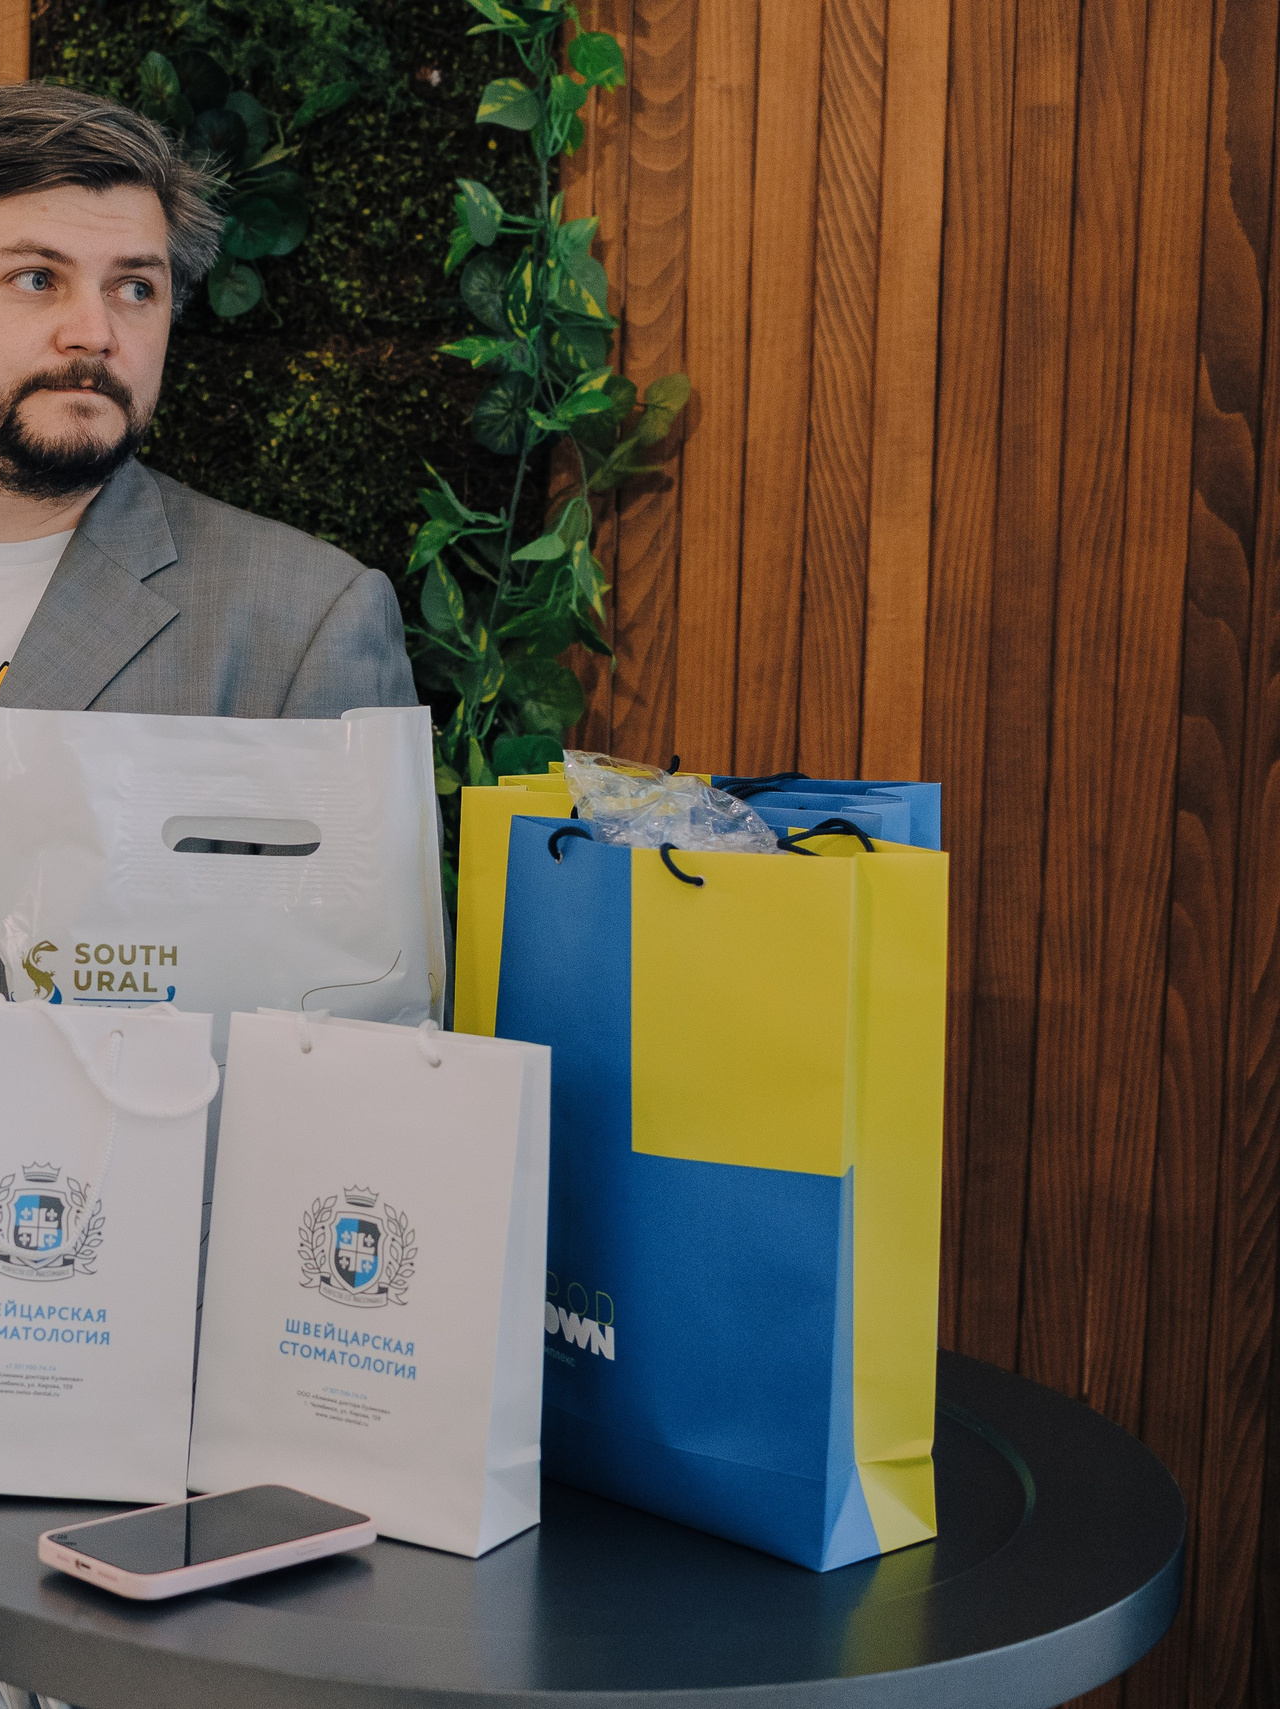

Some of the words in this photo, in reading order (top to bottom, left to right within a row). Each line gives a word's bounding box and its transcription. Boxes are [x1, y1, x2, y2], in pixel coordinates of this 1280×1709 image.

[74, 942, 178, 967] SOUTH
[73, 969, 158, 993] URAL
[285, 1318, 415, 1357] ШВЕЙЦАРСКАЯ
[278, 1340, 417, 1381] СТОМАТОЛОГИЯ
